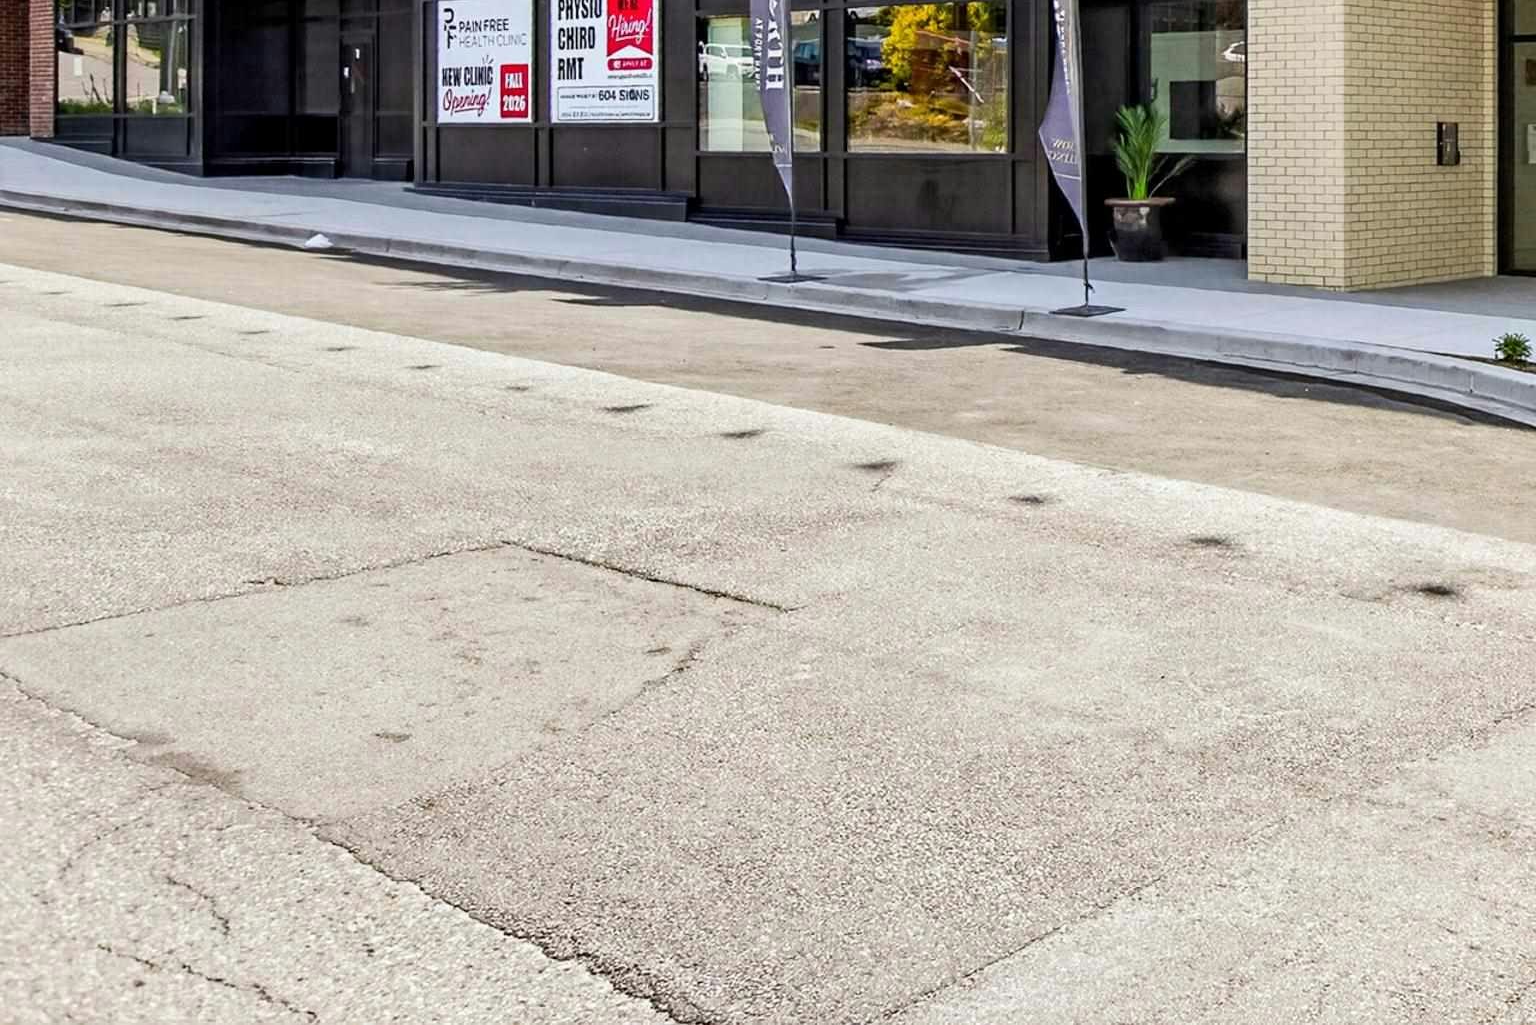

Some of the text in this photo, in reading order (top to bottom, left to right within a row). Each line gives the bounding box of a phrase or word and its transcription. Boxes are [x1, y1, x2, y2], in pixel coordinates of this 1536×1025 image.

[458, 18, 509, 33] PAIN FREE
[607, 7, 652, 45] Hiring!
[458, 35, 495, 48] HEALTH
[557, 26, 596, 50] CHIRO
[442, 66, 493, 87] NEW CLINIC
[557, 57, 584, 80] RMT
[443, 86, 492, 117] Opening!
[598, 90, 617, 101] 604
[618, 88, 650, 101] SIGNS
